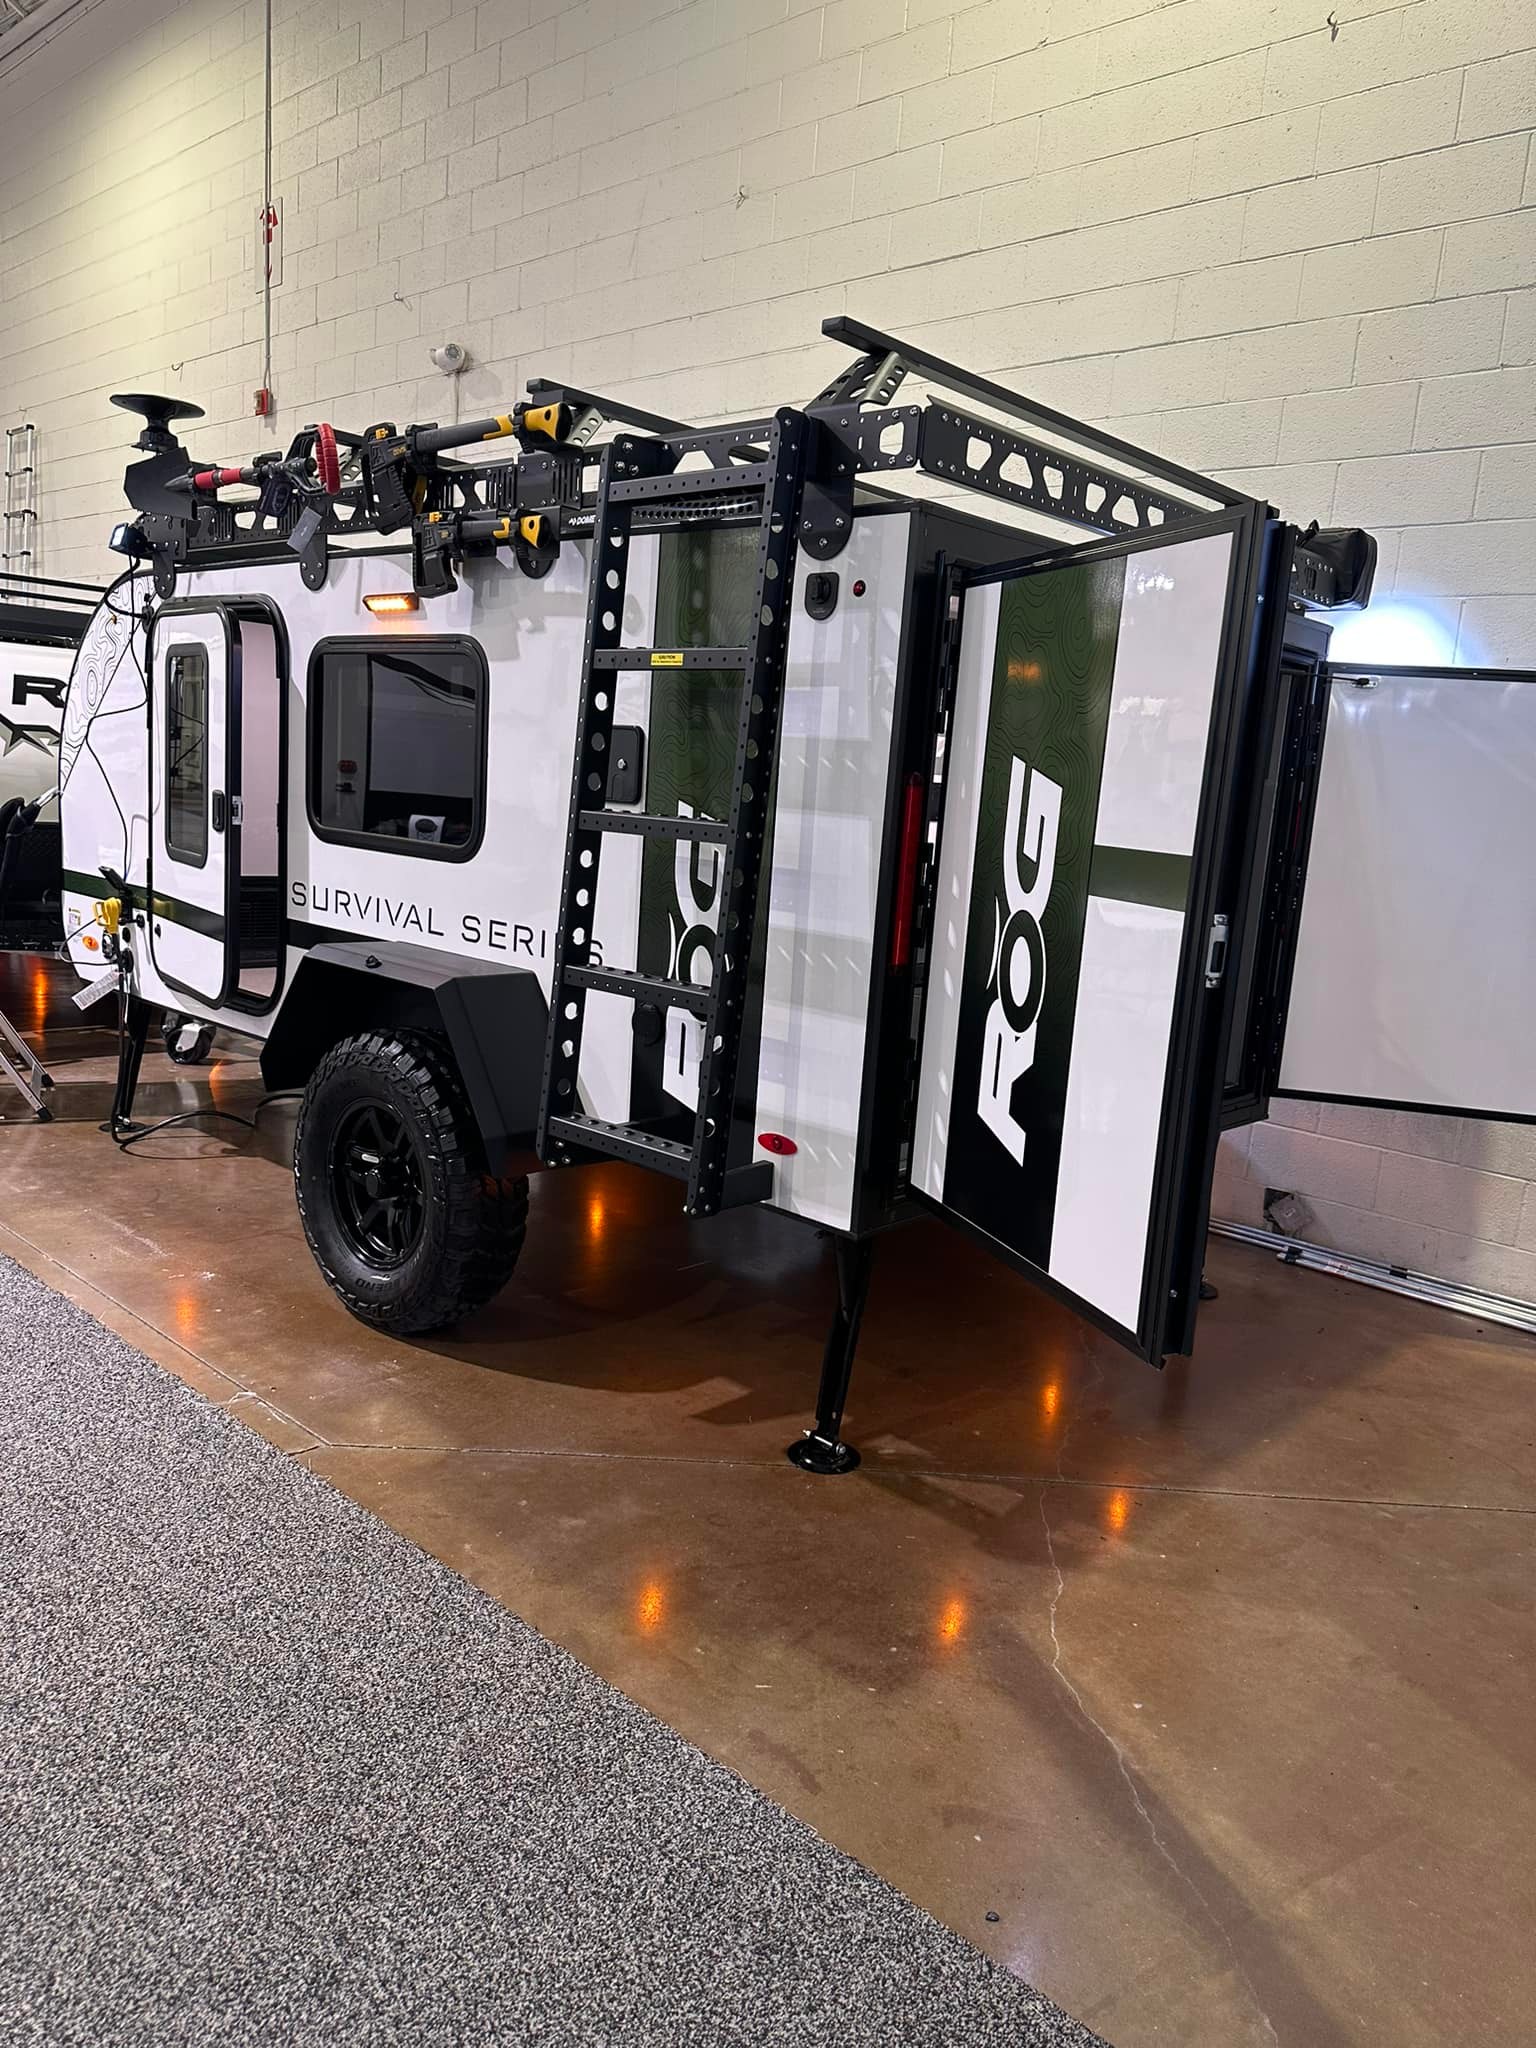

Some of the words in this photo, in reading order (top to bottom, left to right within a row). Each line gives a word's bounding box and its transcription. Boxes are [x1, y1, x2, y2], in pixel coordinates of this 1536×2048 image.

[291, 881, 444, 937] SURVIVAL
[461, 915, 603, 965] SERIS
[977, 755, 1063, 1167] ROG
